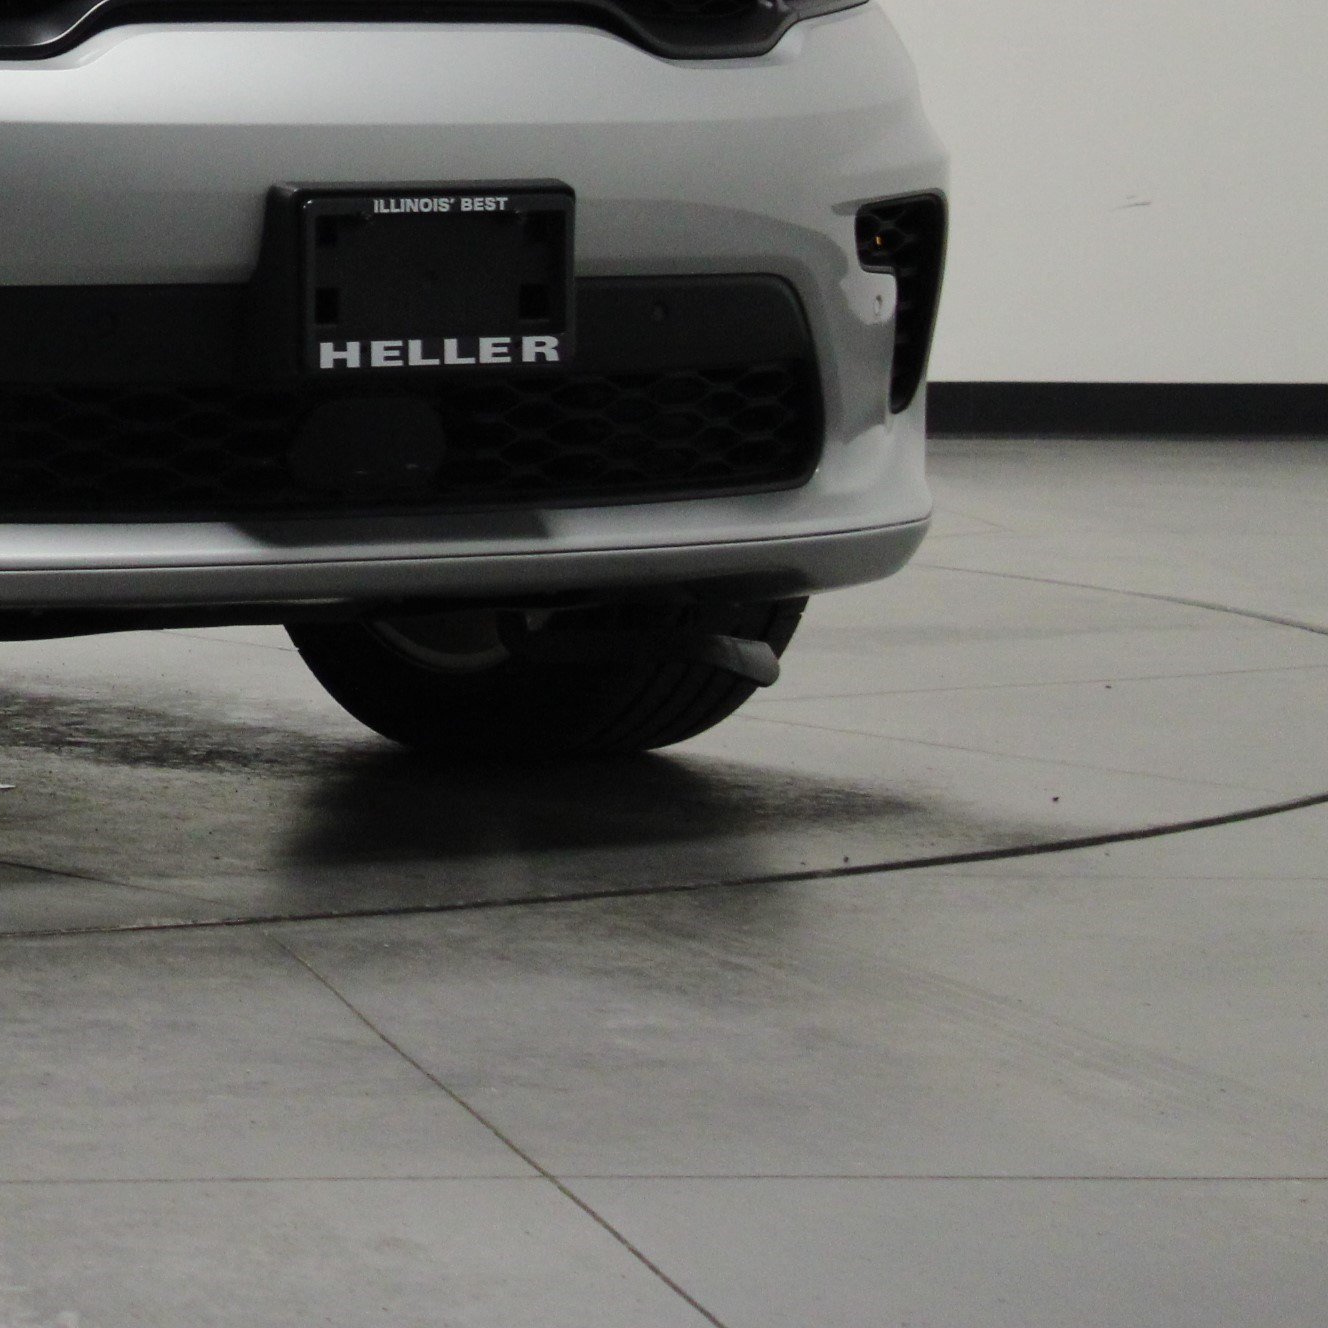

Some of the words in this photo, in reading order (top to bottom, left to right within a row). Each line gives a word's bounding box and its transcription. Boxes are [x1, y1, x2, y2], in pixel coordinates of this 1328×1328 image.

[373, 197, 456, 214] ILLINOIS'
[460, 196, 509, 212] BEST
[319, 335, 560, 369] HELLER
